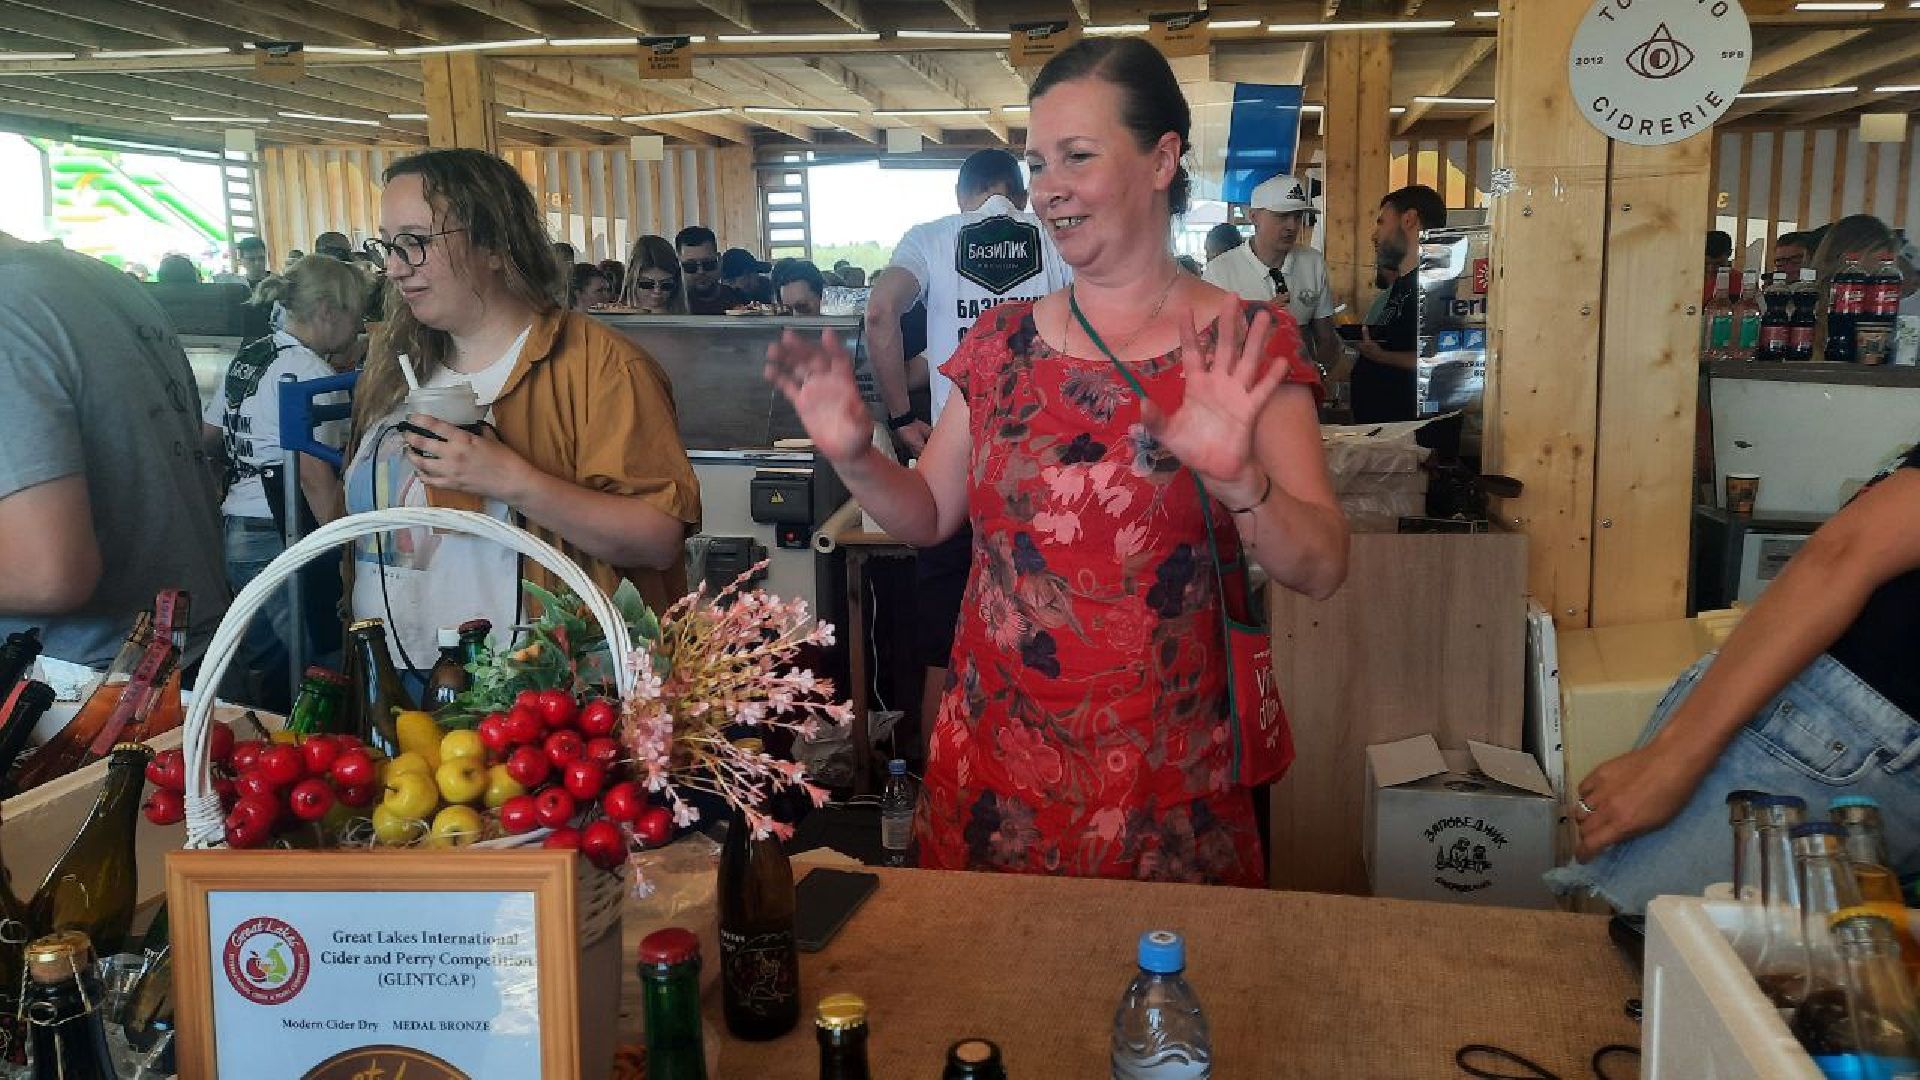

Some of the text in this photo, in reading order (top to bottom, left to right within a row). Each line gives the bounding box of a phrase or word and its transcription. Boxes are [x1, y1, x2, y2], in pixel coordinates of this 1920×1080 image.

[1575, 56, 1603, 65] 2012
[1721, 50, 1744, 59] SPB
[1592, 90, 1723, 136] CIDRERIE
[1424, 816, 1508, 849] ЗАПОВЕДНИК
[231, 918, 300, 947] Great Lakes
[333, 930, 519, 945] Great Lakes International
[320, 951, 361, 964] Cider
[363, 951, 391, 964] and
[395, 952, 435, 969] Perry
[378, 972, 476, 989] (GLINTCAP)
[281, 1019, 491, 1032] Modern Cider Dry MEDAL BRONZE
